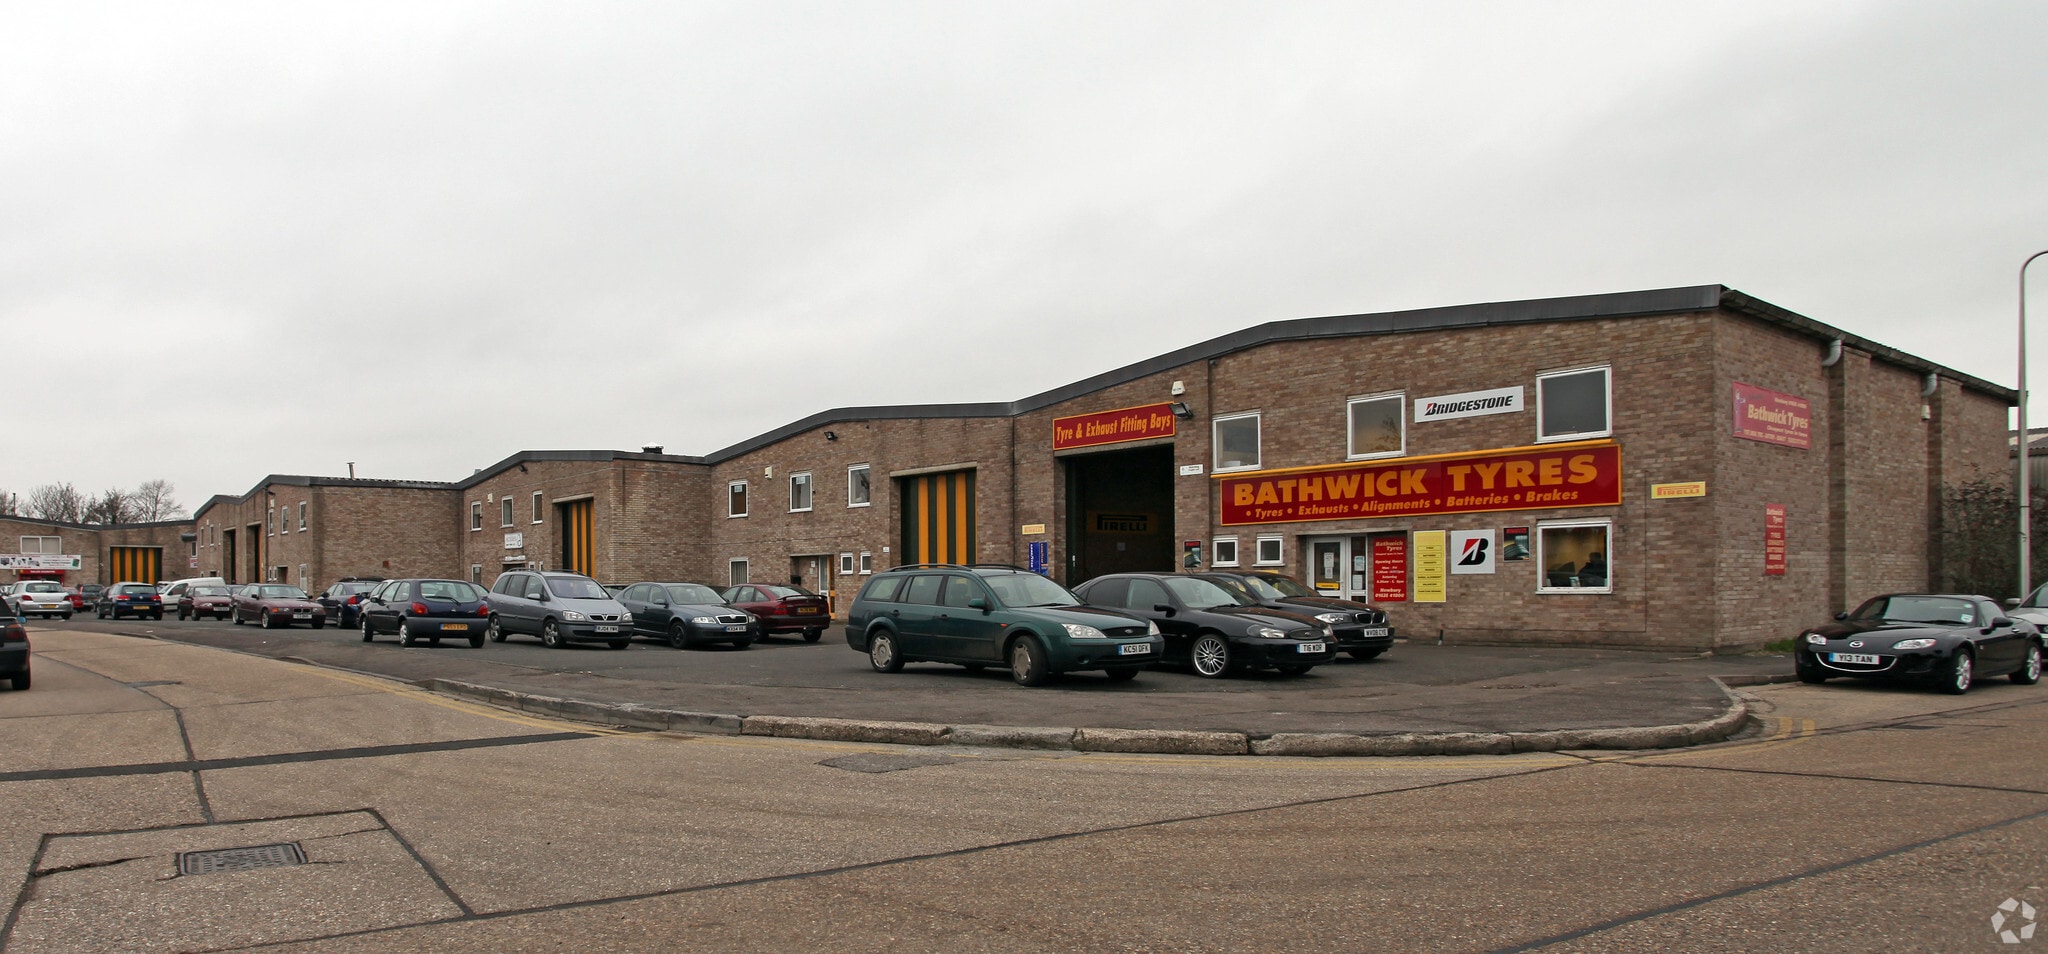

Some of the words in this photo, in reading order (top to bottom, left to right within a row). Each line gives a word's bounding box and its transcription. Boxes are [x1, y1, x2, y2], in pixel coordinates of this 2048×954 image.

[1424, 395, 1514, 416] BRIDGESTONE
[1748, 403, 1786, 425] Bathwick
[1787, 412, 1808, 430] Tyres
[1056, 427, 1073, 444] Tyre
[1075, 423, 1083, 439] &
[1085, 420, 1118, 437] Exhaust
[1120, 414, 1147, 433] Fitting
[1150, 413, 1171, 431] Bays
[1234, 468, 1429, 507] BATHWICK
[1447, 454, 1598, 492] TYRES
[1657, 485, 1700, 496] PIRELLI
[1255, 507, 1283, 519] Tyres
[1298, 503, 1349, 516] Exhausts
[1361, 498, 1431, 513] Alignments
[1446, 493, 1509, 507] Batteries
[1525, 489, 1578, 502] Brakes
[1097, 514, 1148, 531] PIRELLI
[1123, 645, 1138, 653] KC51
[1138, 644, 1149, 652] DFK
[1303, 644, 1312, 652] T16
[1854, 655, 1873, 663] TAN
